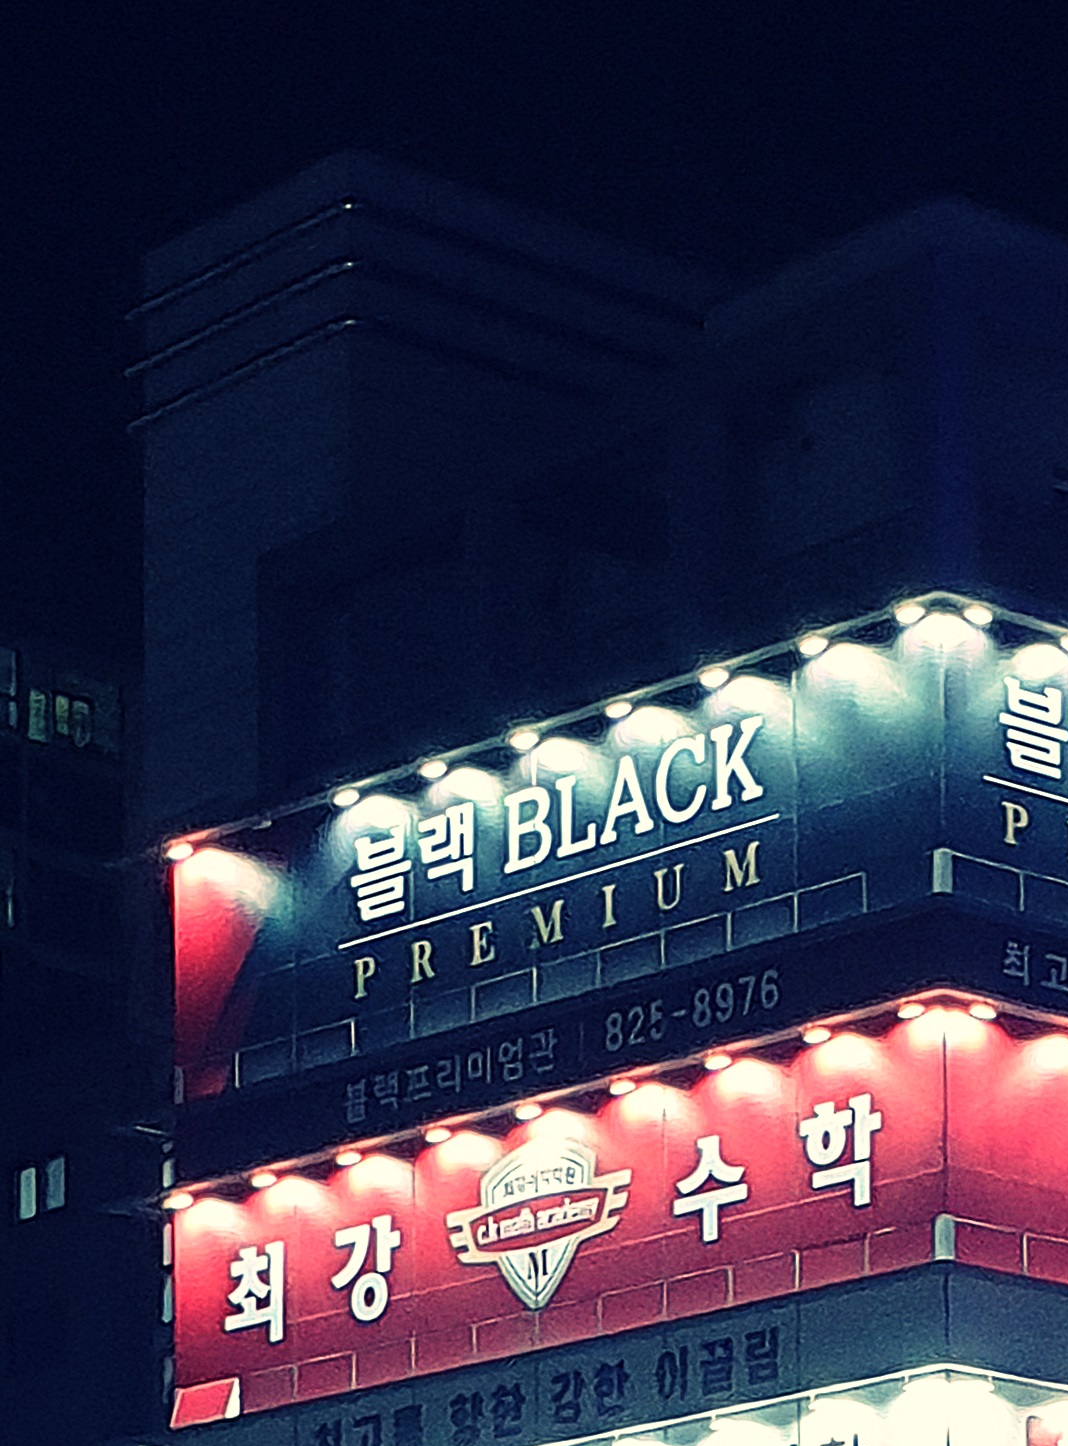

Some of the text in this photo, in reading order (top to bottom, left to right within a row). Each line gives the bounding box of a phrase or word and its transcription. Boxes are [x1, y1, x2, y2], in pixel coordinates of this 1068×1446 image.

[351, 716, 765, 921] 블랙 BLACK
[353, 842, 760, 1000] PREMIUM
[345, 969, 780, 1123] 블랙프리미엄관 825-8976
[224, 1093, 882, 1345] 최강 수학
